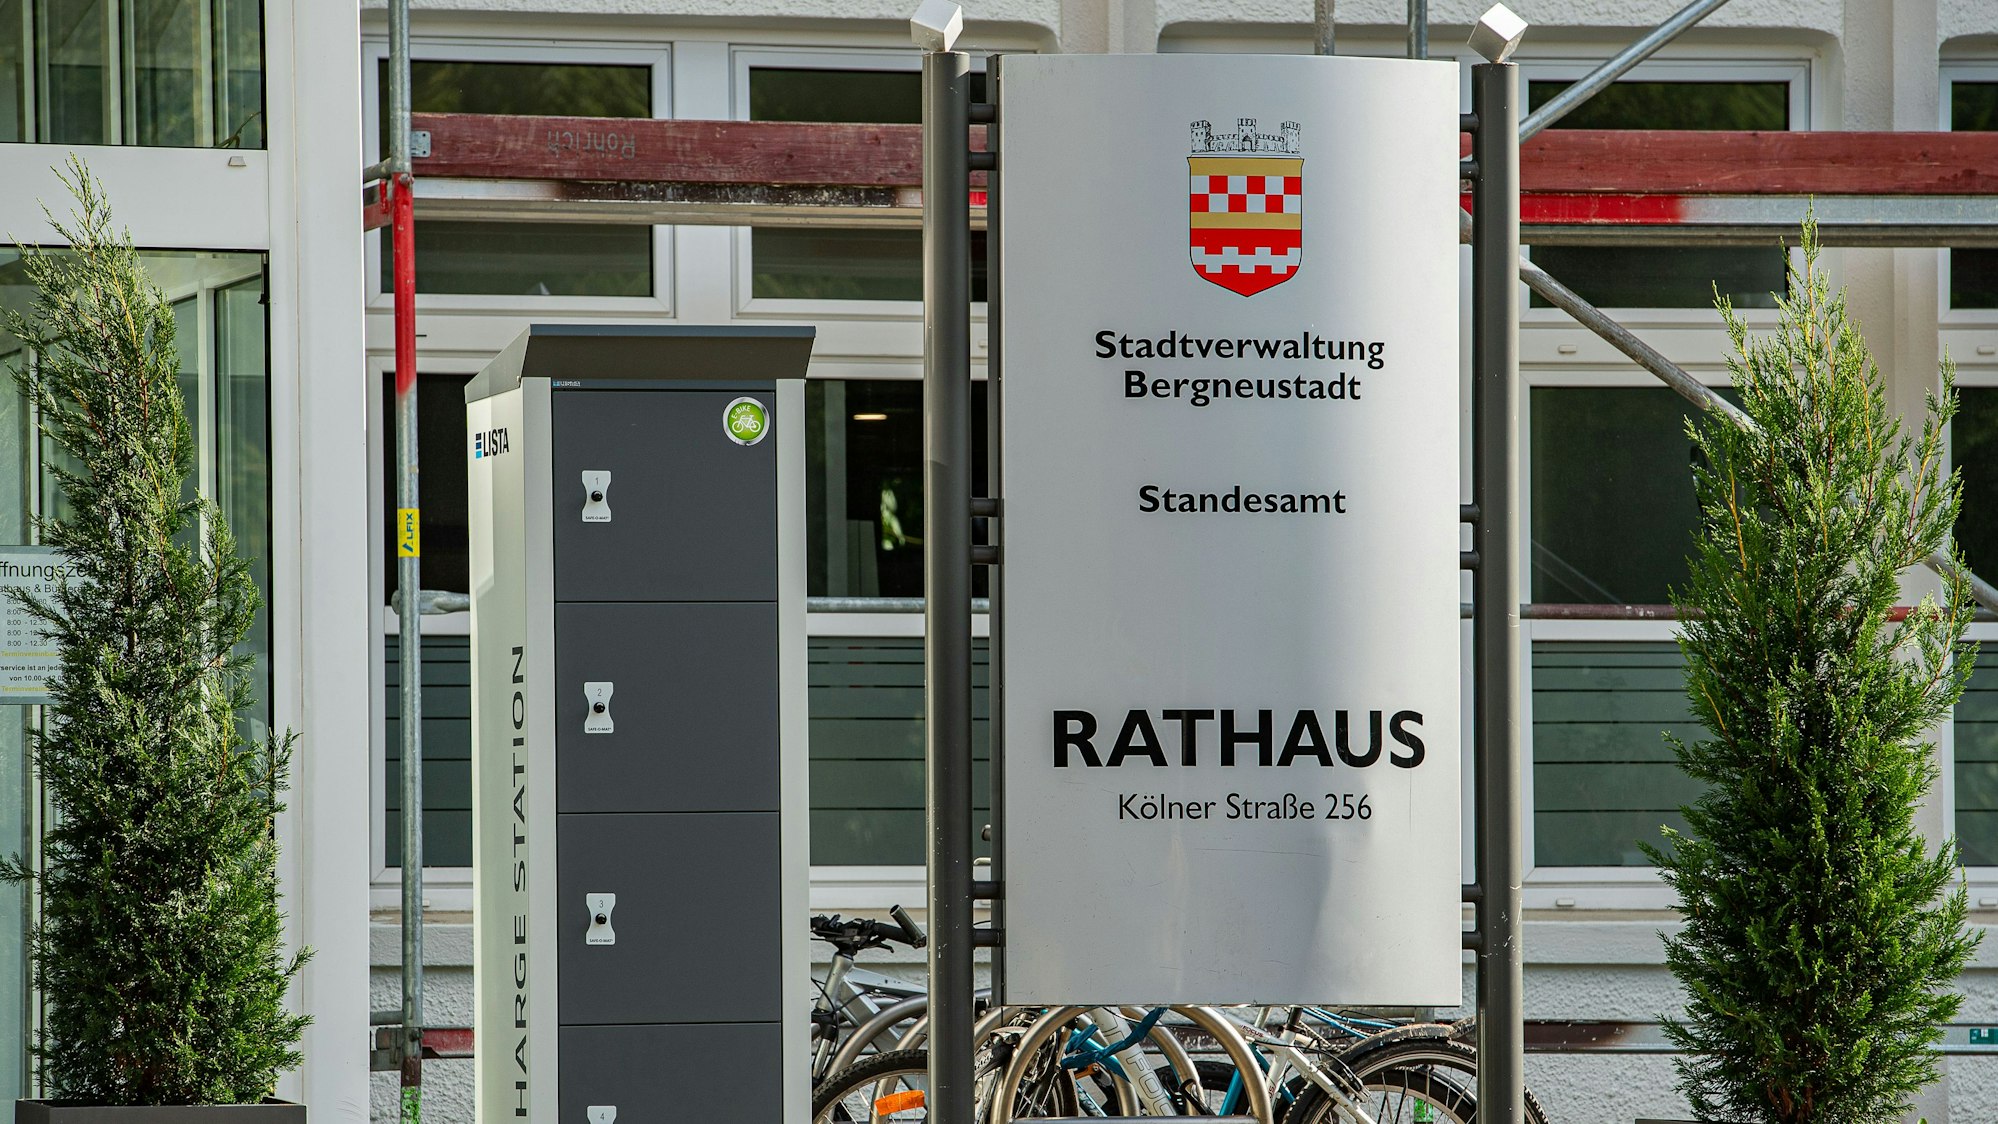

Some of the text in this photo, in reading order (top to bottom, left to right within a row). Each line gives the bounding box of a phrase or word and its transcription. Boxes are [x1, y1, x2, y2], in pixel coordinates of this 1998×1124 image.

[1095, 331, 1386, 370] Stadtverwaltung
[1124, 371, 1361, 407] Bergneustadt
[731, 405, 752, 419] E-BIKE
[483, 428, 510, 457] LISTA
[1139, 485, 1347, 514] Standesamt
[34, 584, 41, 593] &
[597, 688, 602, 697] 2
[1053, 709, 1426, 769] RATHAUS
[511, 646, 526, 893] STATION
[1118, 793, 1372, 820] Kölner Straße 256
[599, 900, 604, 908] 3
[1242, 1025, 1265, 1038] FOCUS
[600, 1112, 605, 1120] 4
